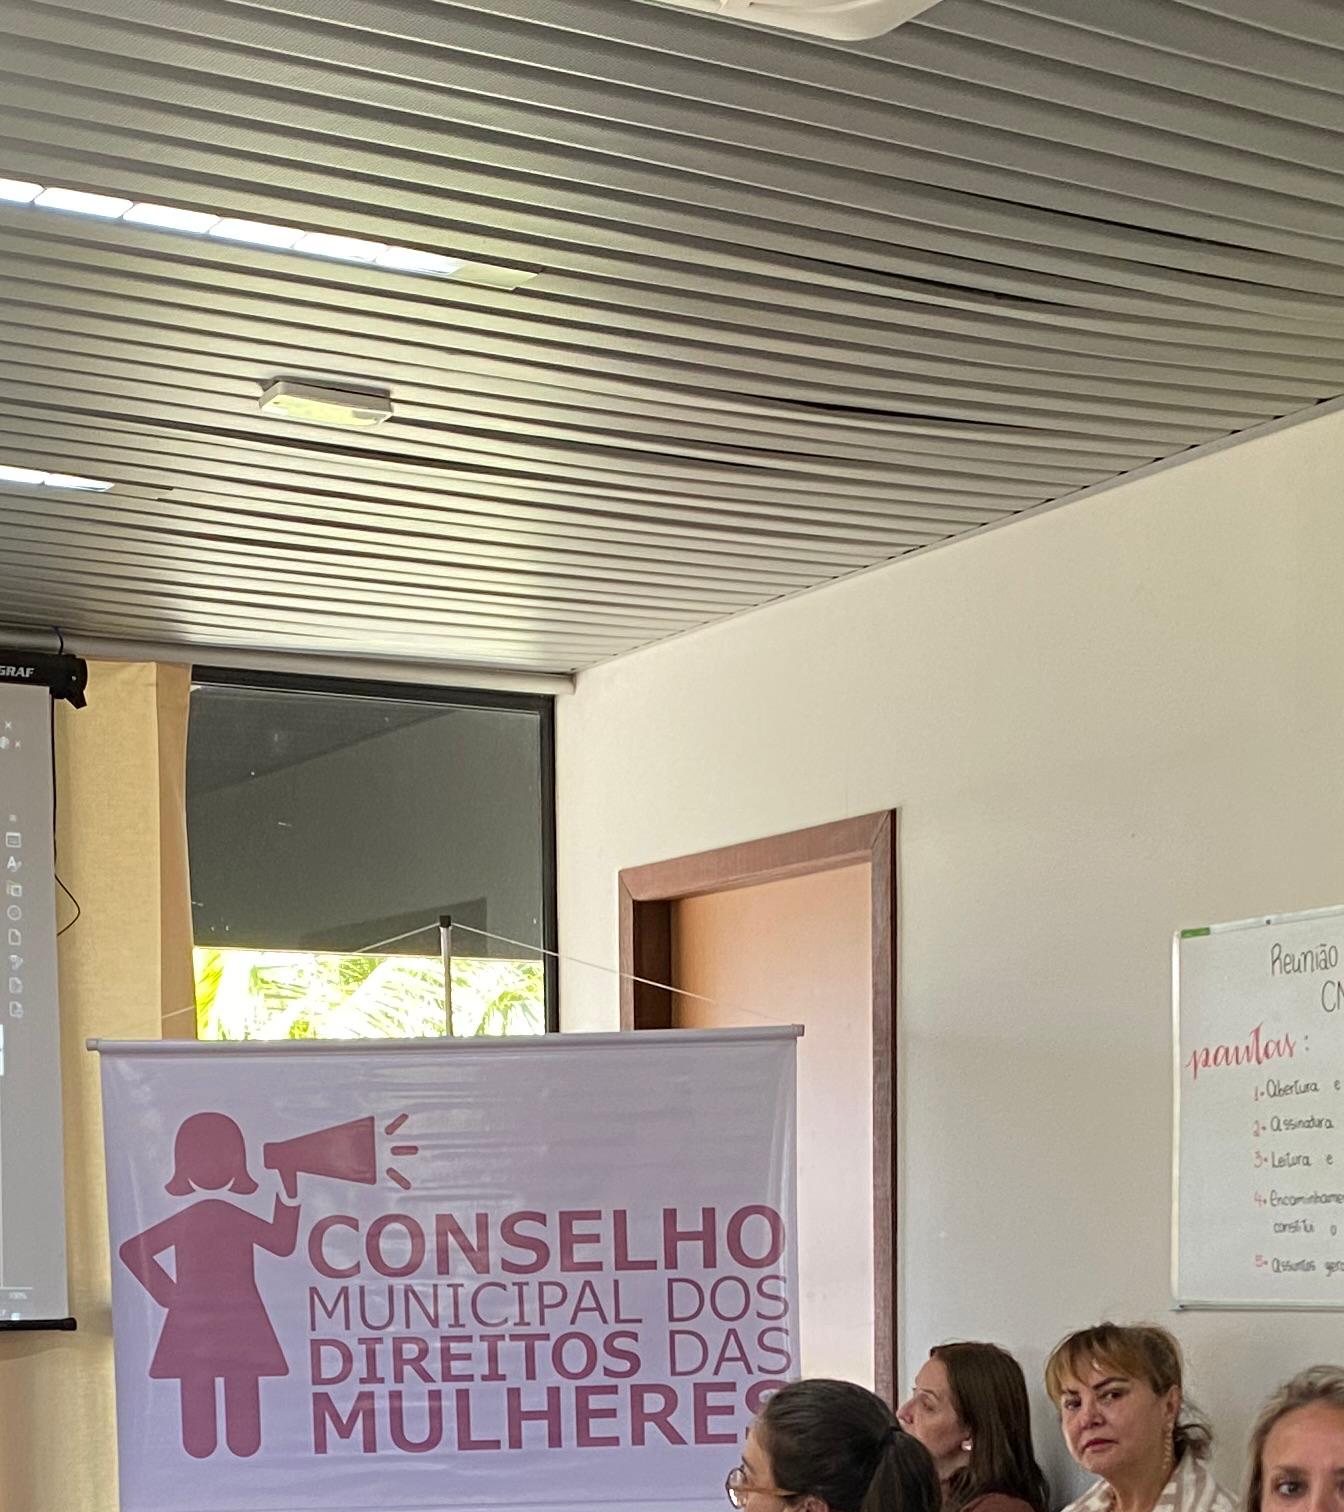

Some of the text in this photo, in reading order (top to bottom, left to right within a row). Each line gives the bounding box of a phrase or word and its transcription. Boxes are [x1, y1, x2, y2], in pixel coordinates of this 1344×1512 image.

[1270, 943, 1339, 976] Reunião
[1334, 1079, 1341, 1091] e
[1271, 1151, 1312, 1168] Leitura
[1326, 1153, 1334, 1165] e
[307, 1204, 786, 1279] CONSELHO
[1330, 1224, 1337, 1236] o
[309, 1274, 789, 1332] MUNICIPAL DOS
[310, 1327, 792, 1386] DIREITOS DAS
